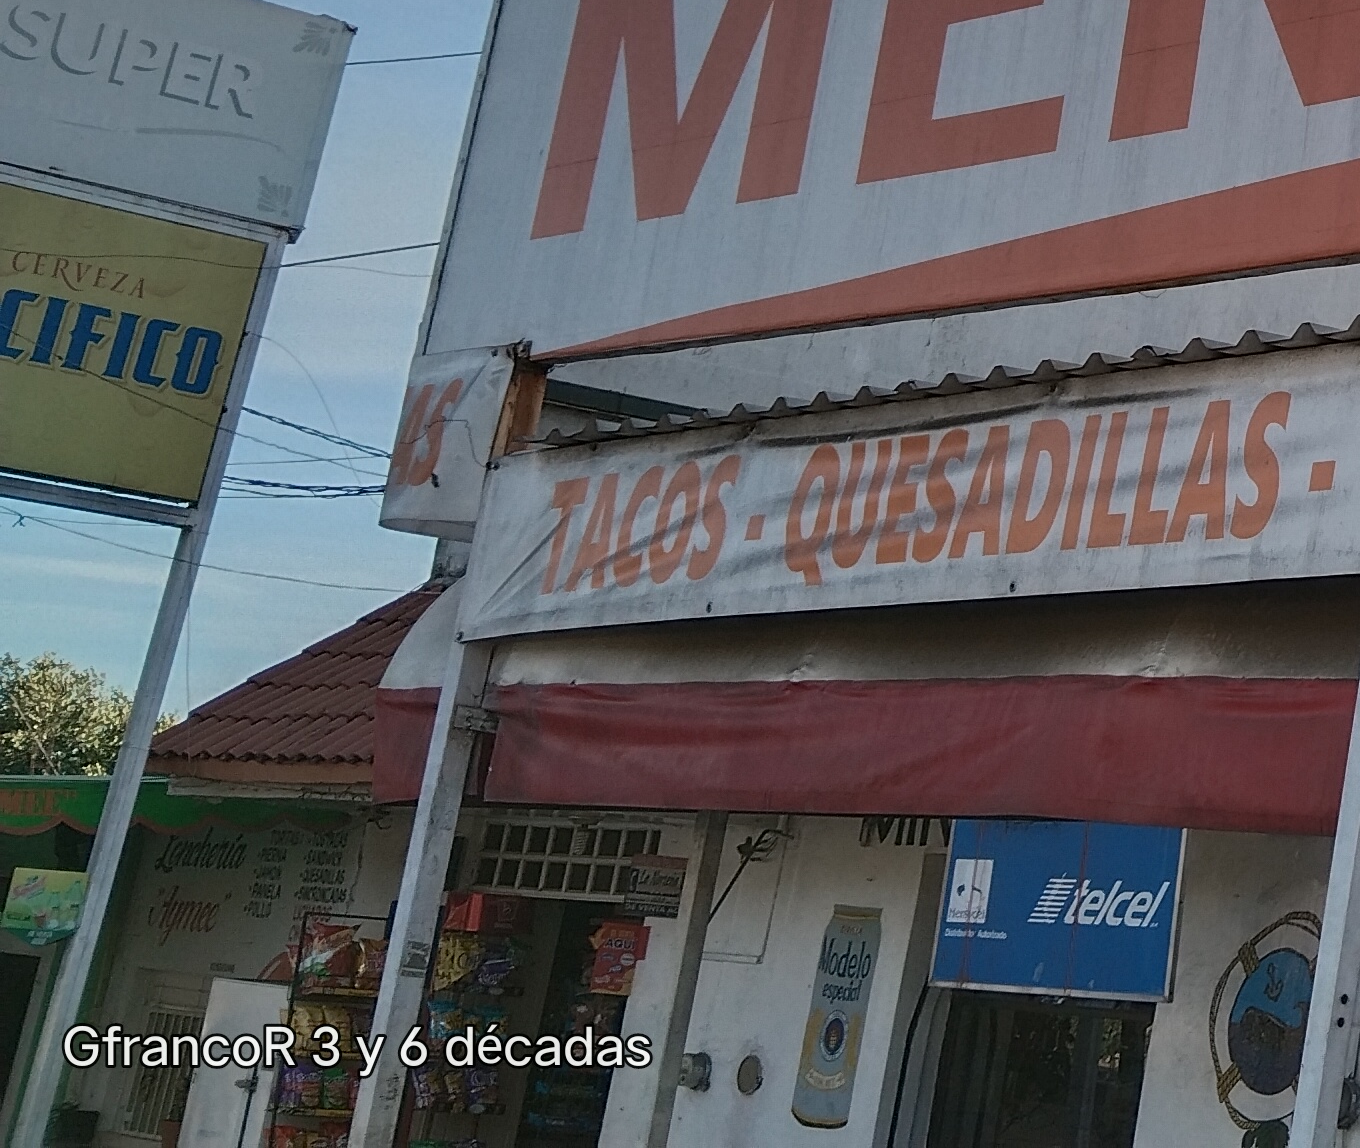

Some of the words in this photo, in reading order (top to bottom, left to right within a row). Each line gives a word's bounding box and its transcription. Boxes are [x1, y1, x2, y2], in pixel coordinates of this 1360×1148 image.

[1, 4, 255, 120] SUPER
[12, 251, 146, 299] CERVEZA
[0, 288, 224, 395] CIFICO
[538, 456, 743, 598] TACOS
[783, 390, 1291, 587] QUESADILLAS
[1063, 879, 1170, 928] telcel
[818, 936, 872, 979] Modelo
[821, 980, 863, 1004] especial
